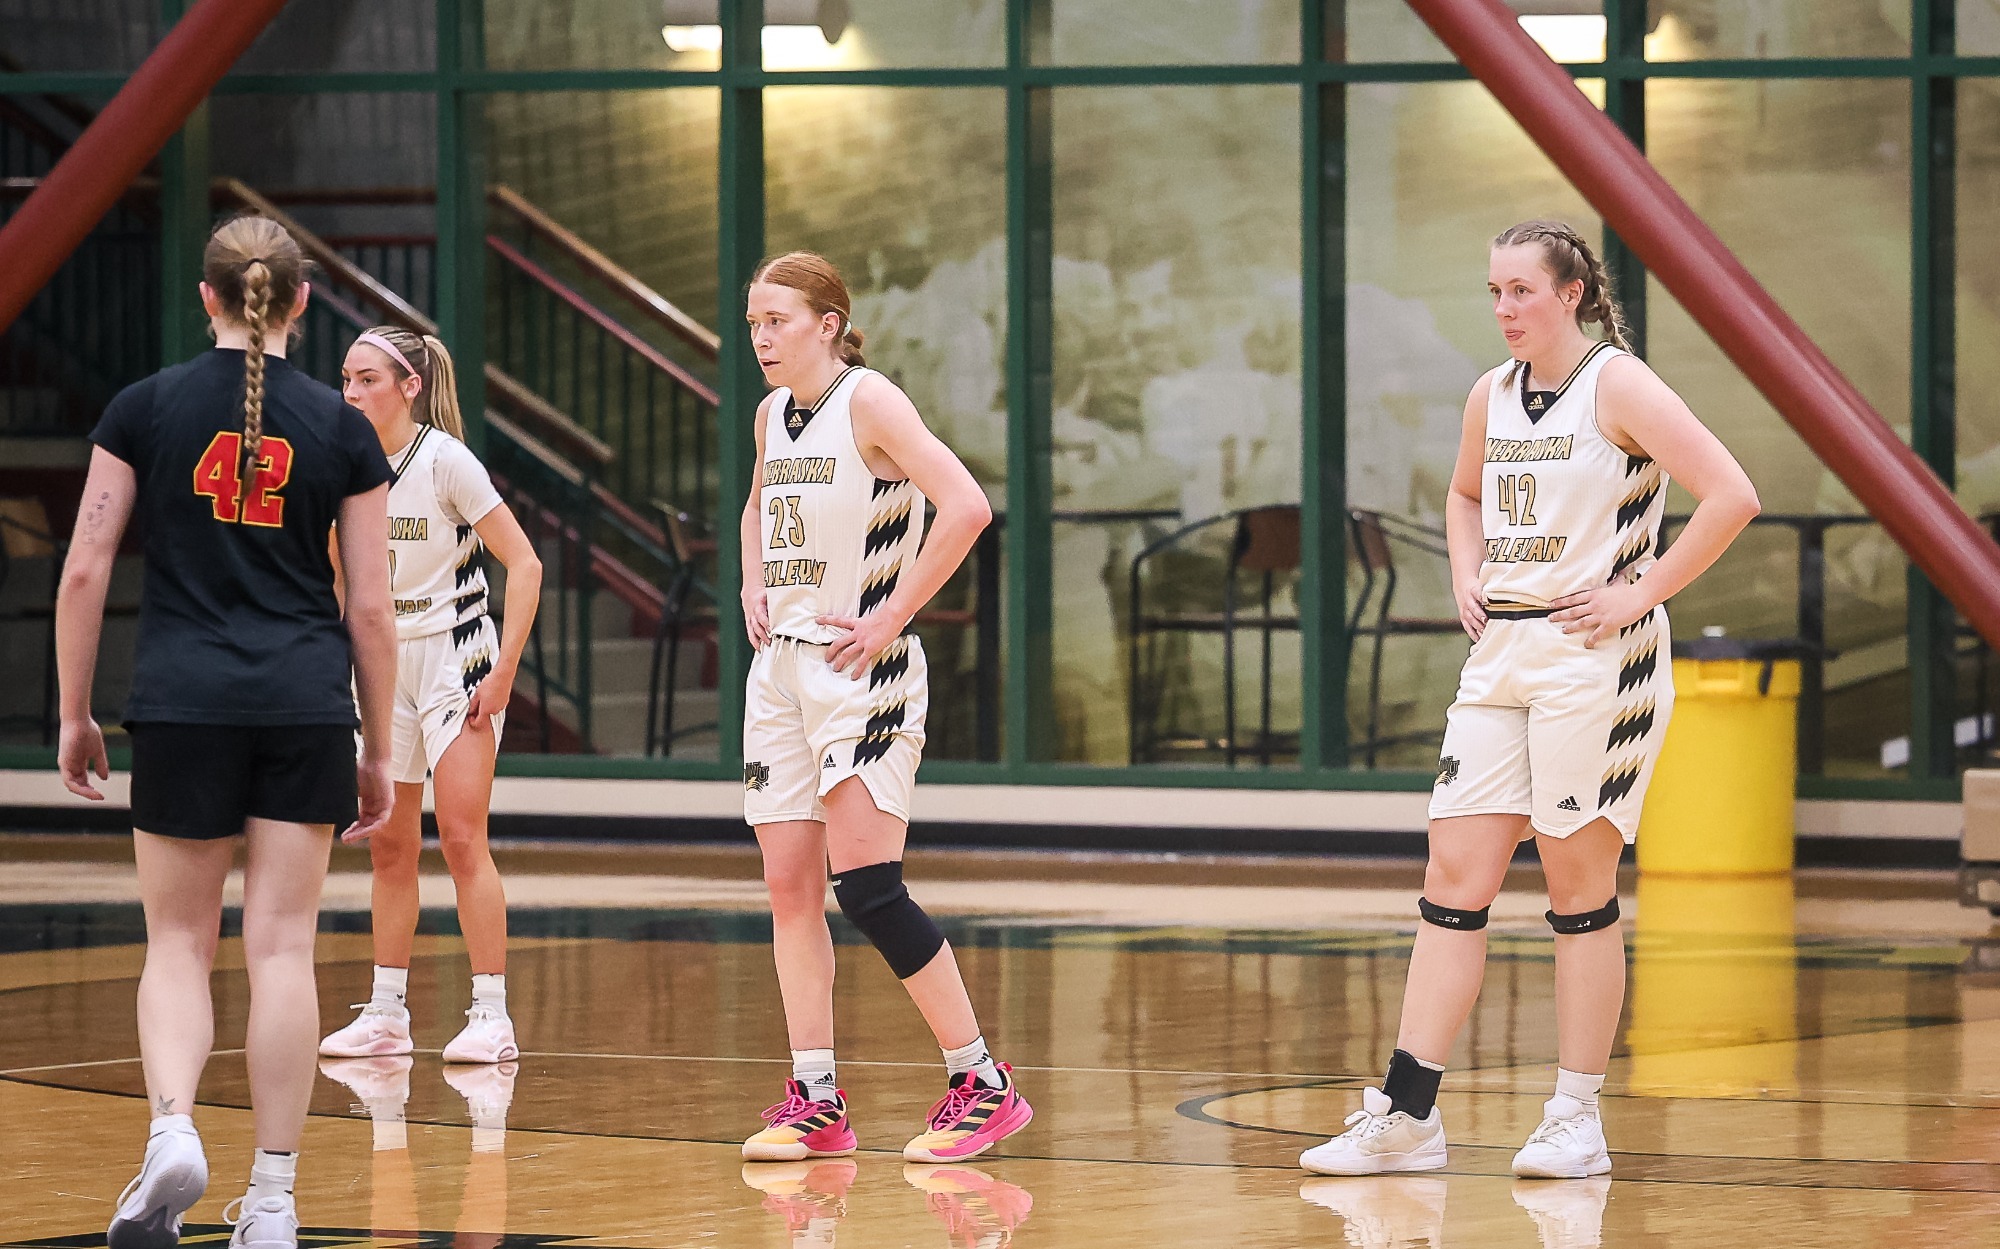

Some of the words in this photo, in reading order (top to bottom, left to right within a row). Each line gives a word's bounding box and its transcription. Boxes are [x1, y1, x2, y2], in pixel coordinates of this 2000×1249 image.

[193, 430, 295, 528] 42
[1498, 473, 1537, 526] 42
[769, 496, 805, 549] 23
